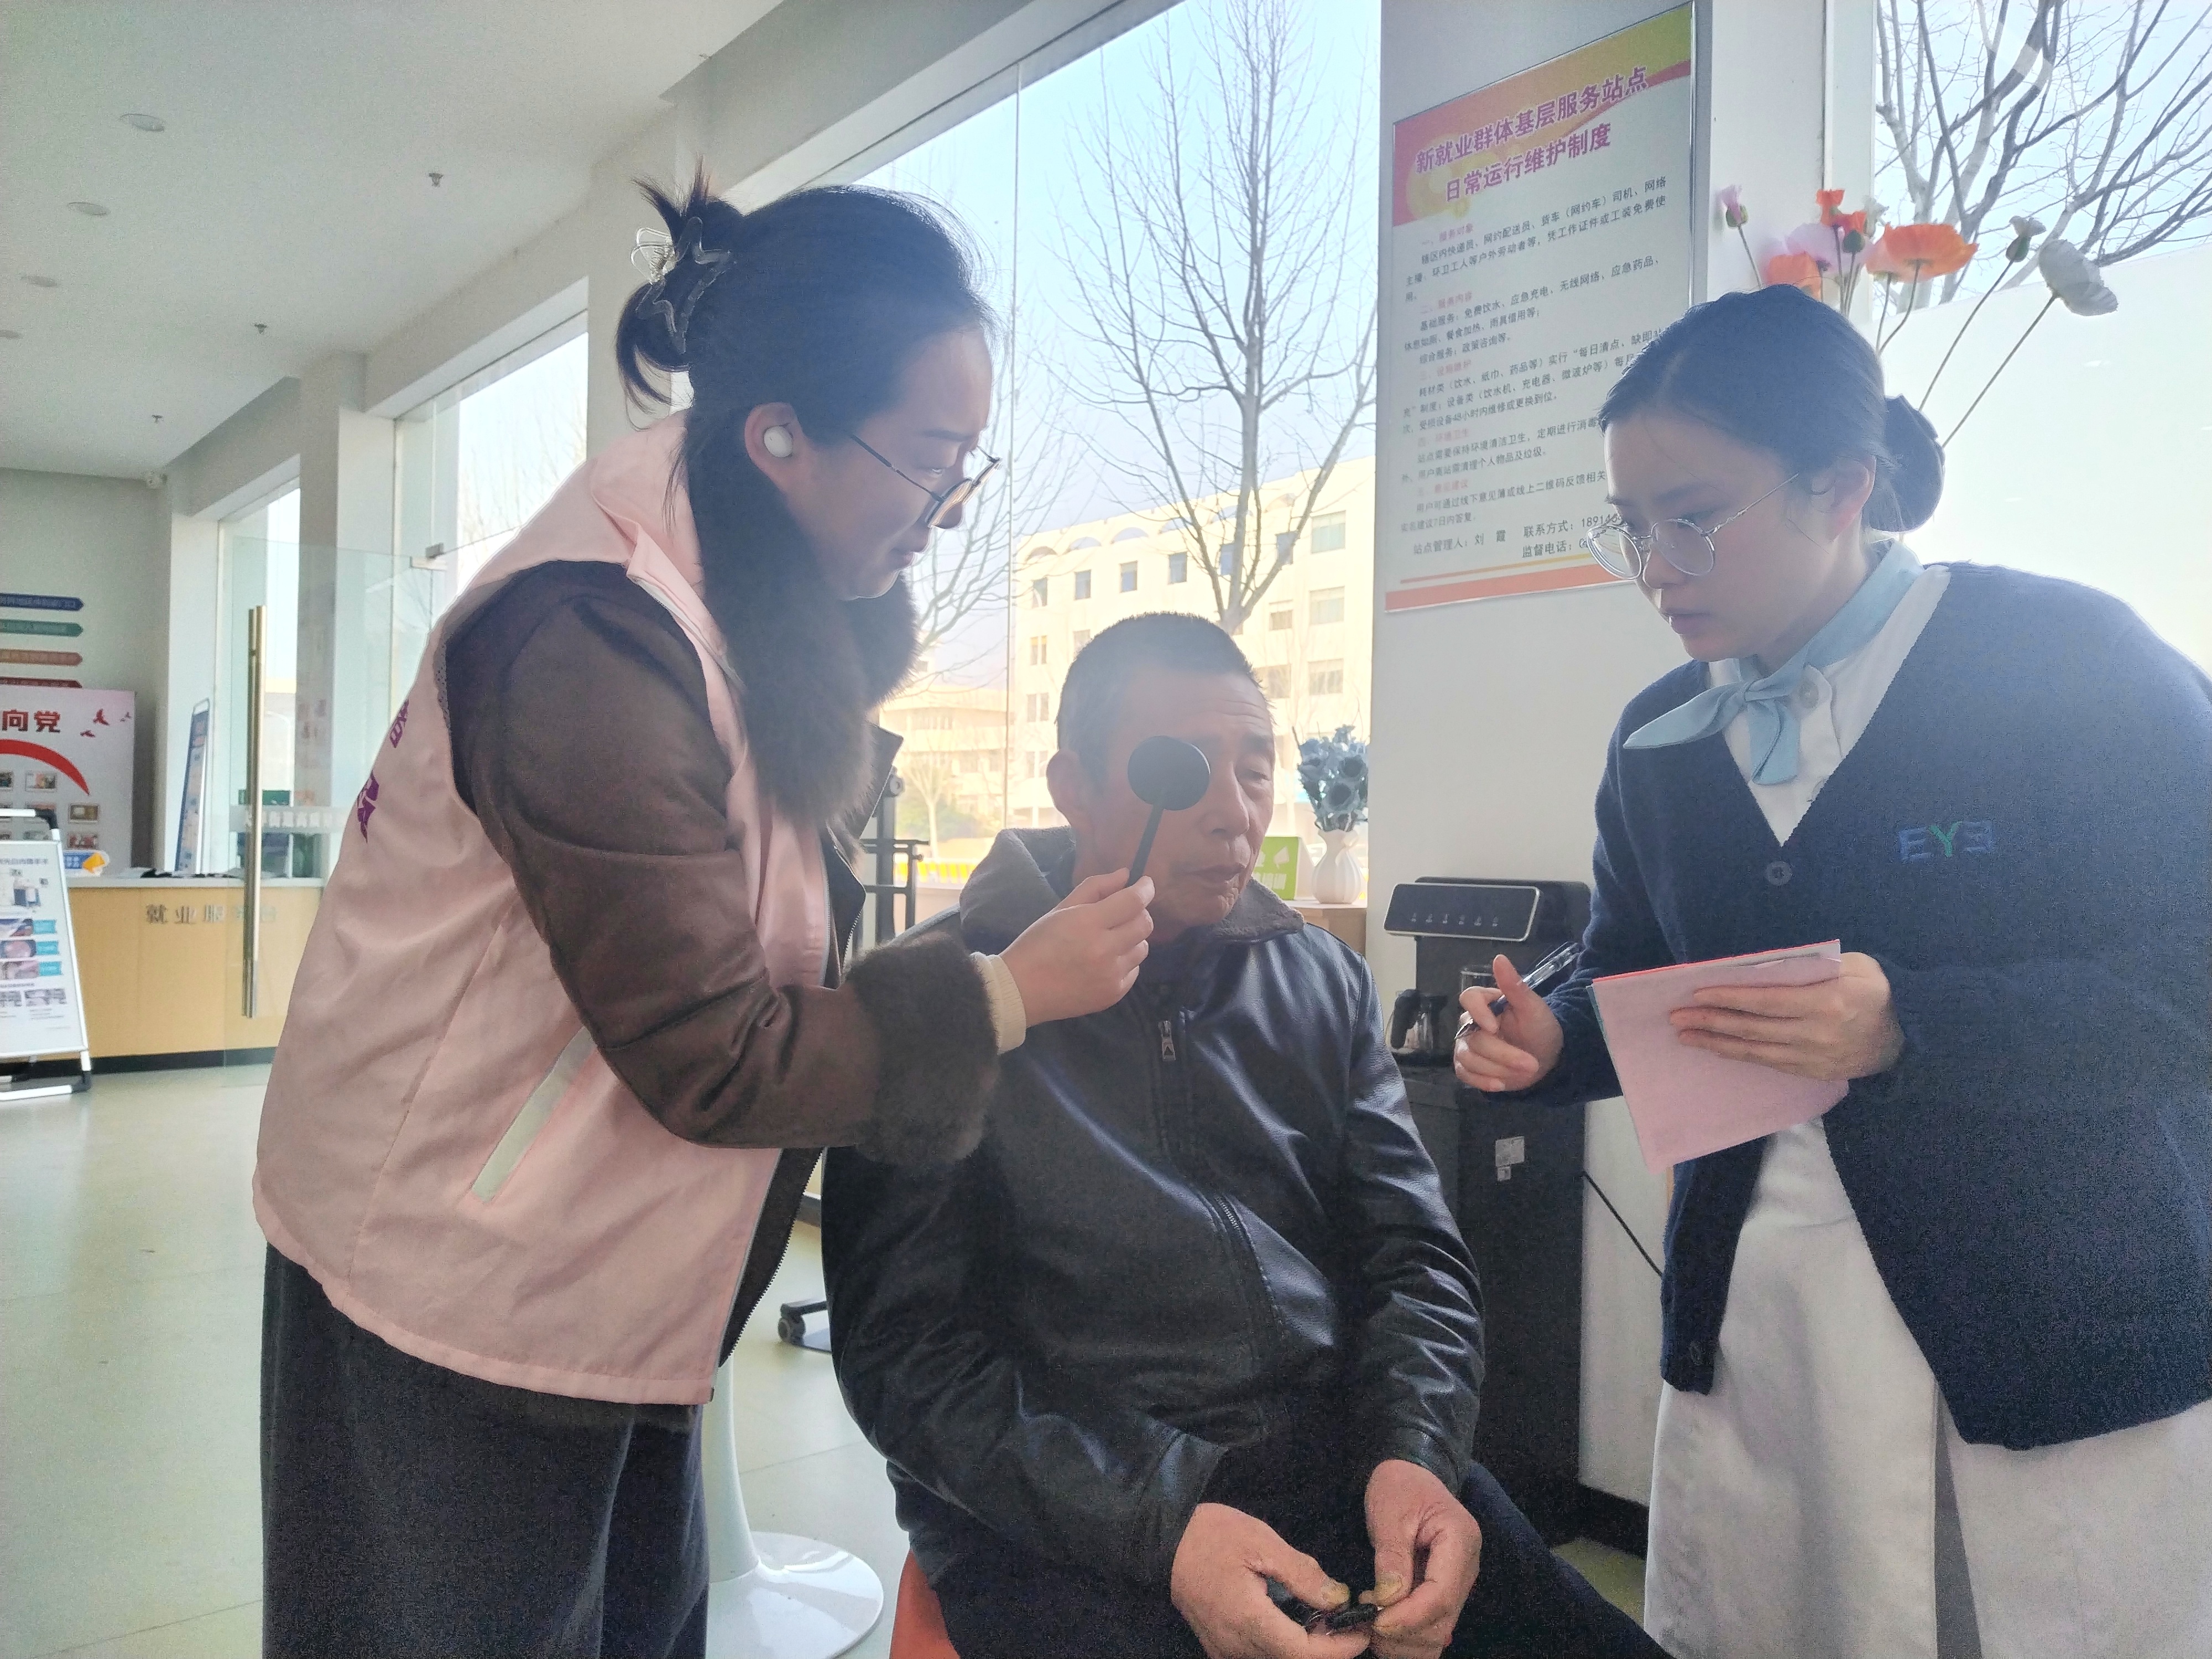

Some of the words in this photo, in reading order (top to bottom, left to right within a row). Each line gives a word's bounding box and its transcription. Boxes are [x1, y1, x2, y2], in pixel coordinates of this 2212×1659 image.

[1416, 63, 1647, 175] 新就业群体基层服务站点
[1446, 121, 1610, 204] 日常运行维护制度
[2, 709, 61, 733] 向党
